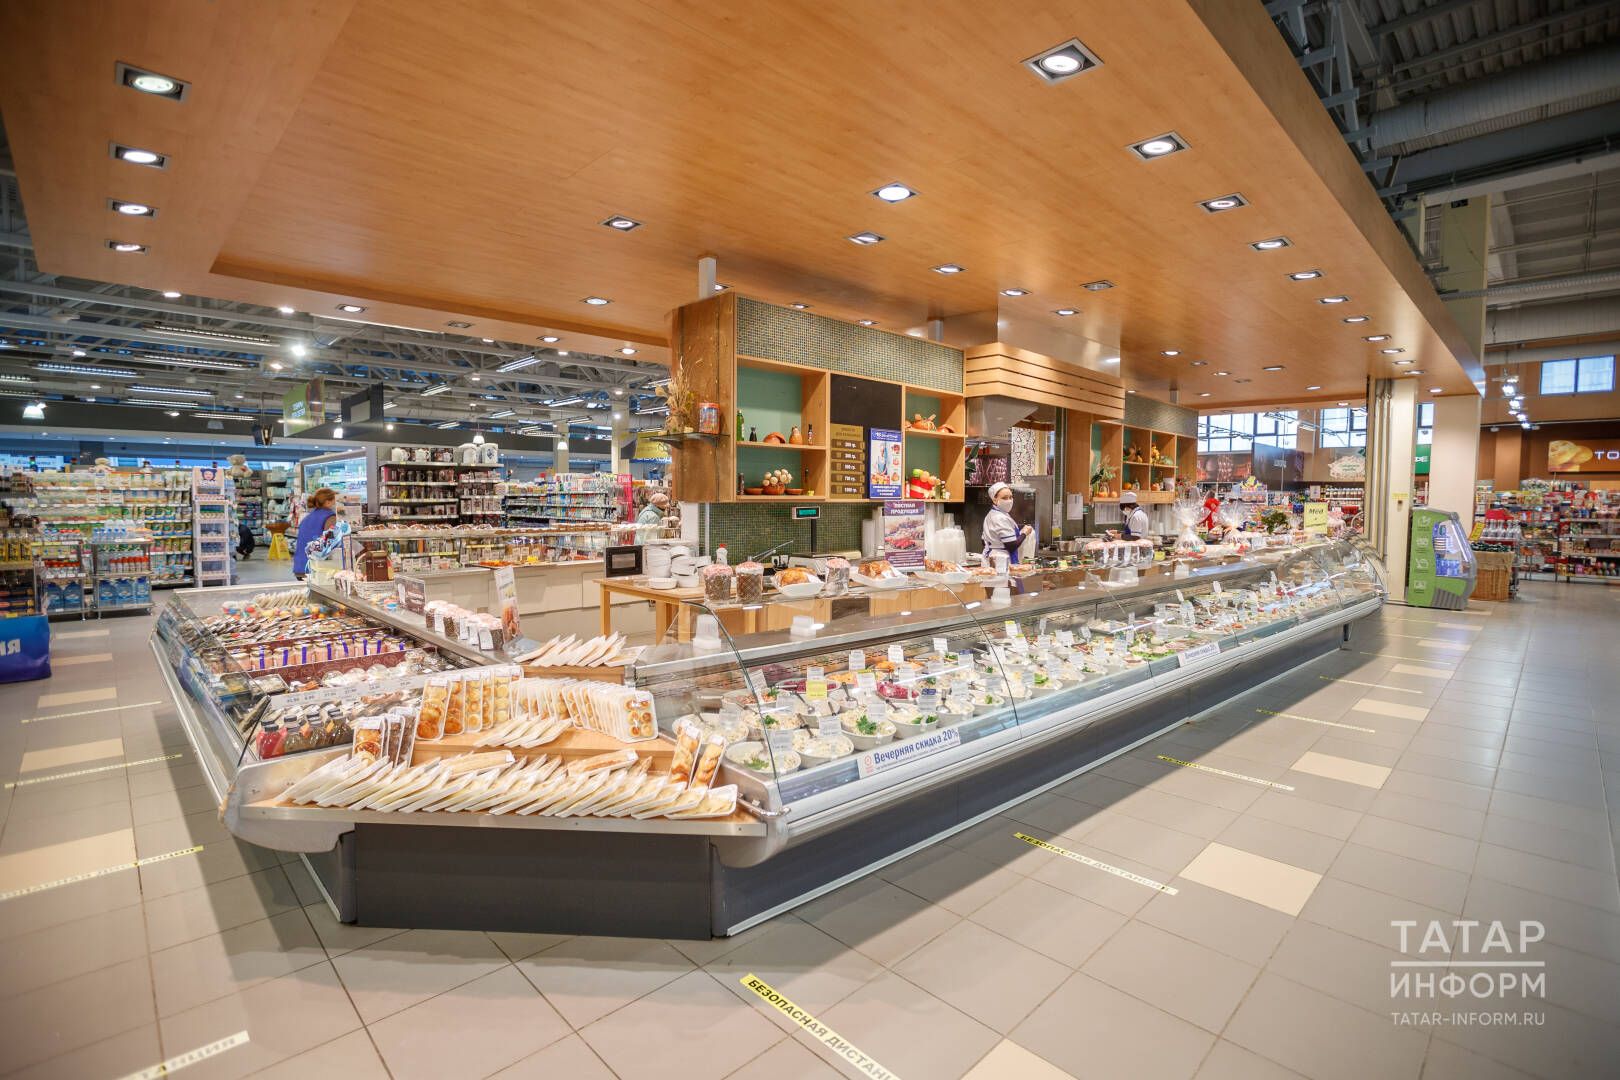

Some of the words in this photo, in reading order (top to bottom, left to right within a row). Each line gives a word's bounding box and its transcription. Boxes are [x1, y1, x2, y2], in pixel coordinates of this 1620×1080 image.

[874, 744, 915, 764] Вечерняя
[915, 735, 942, 751] скидка
[942, 728, 960, 741] 20%
[748, 979, 828, 1038] БЕЗОПАСНАЯ
